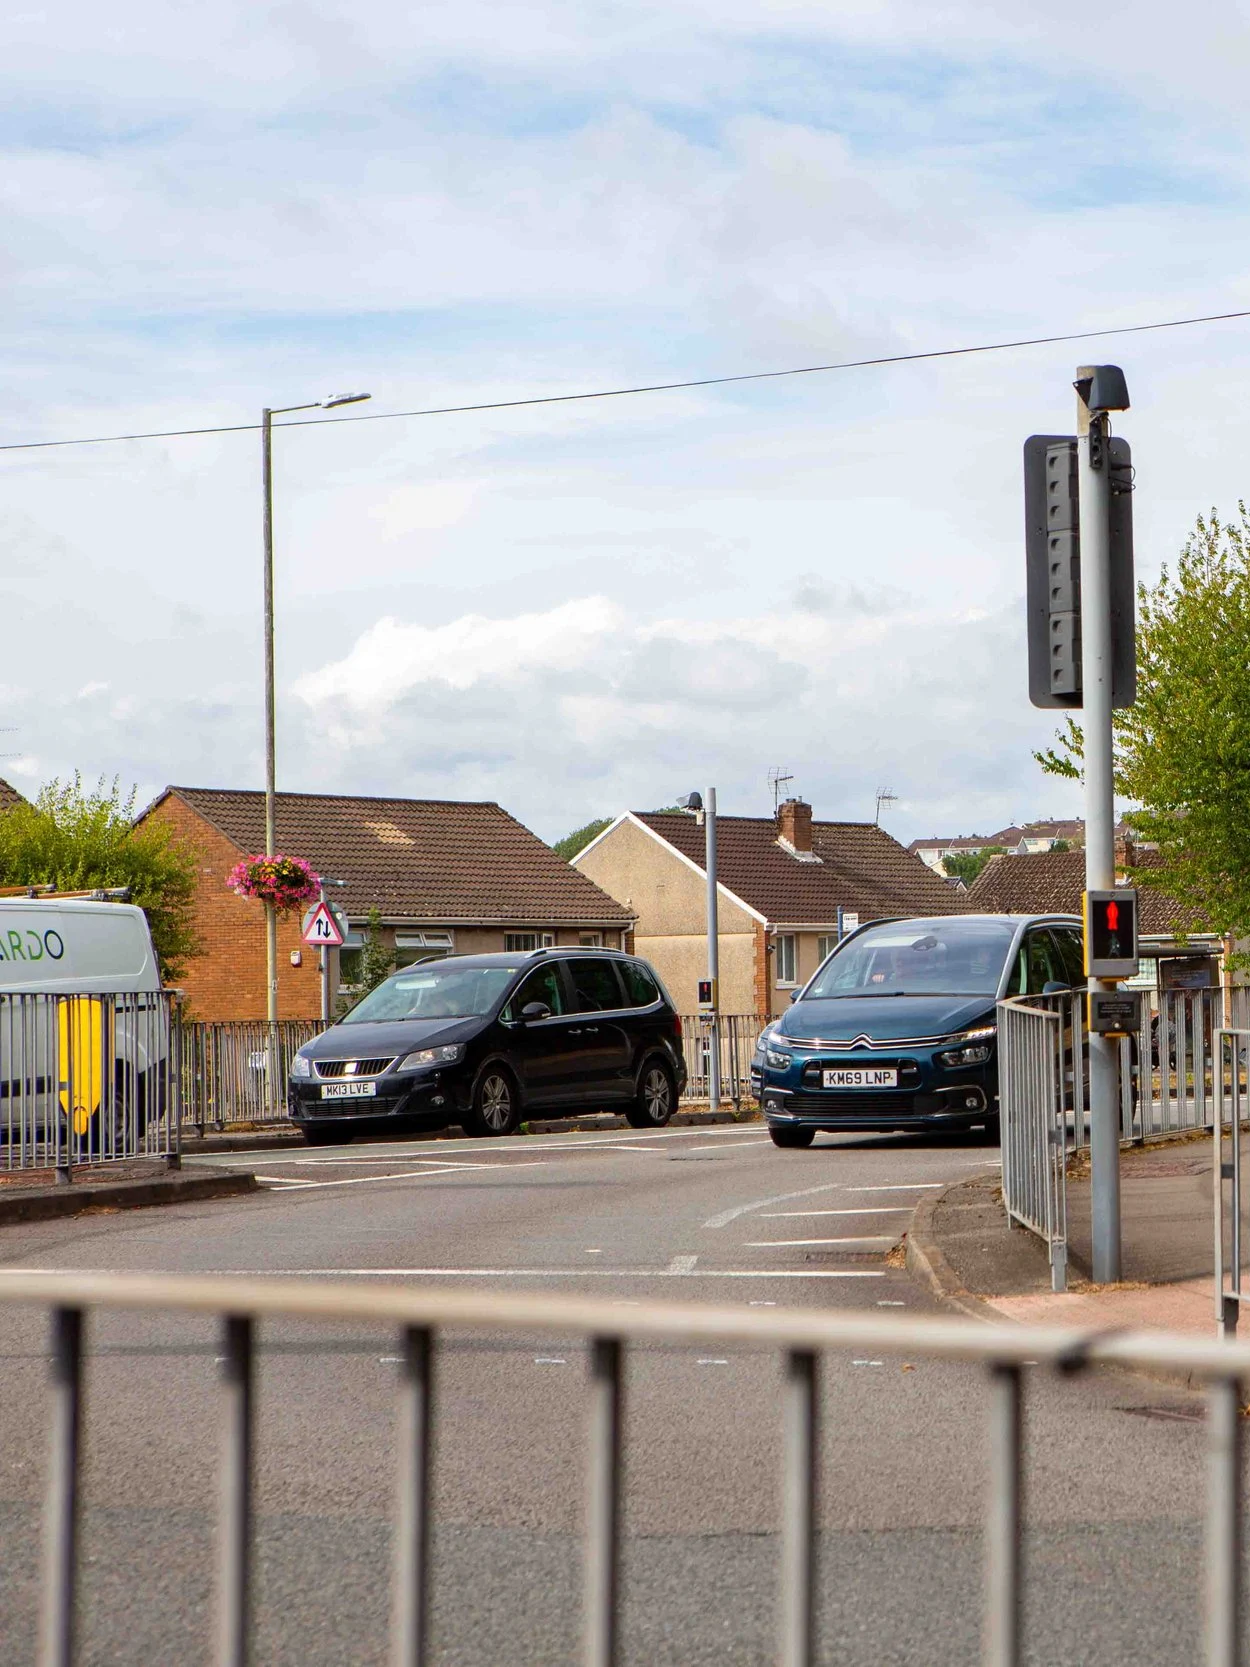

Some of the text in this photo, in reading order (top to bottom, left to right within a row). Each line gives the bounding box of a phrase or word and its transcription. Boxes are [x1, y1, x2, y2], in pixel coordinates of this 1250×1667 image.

[828, 1071, 891, 1085] KM69 LNP
[326, 1083, 369, 1096] MK13 LVE
